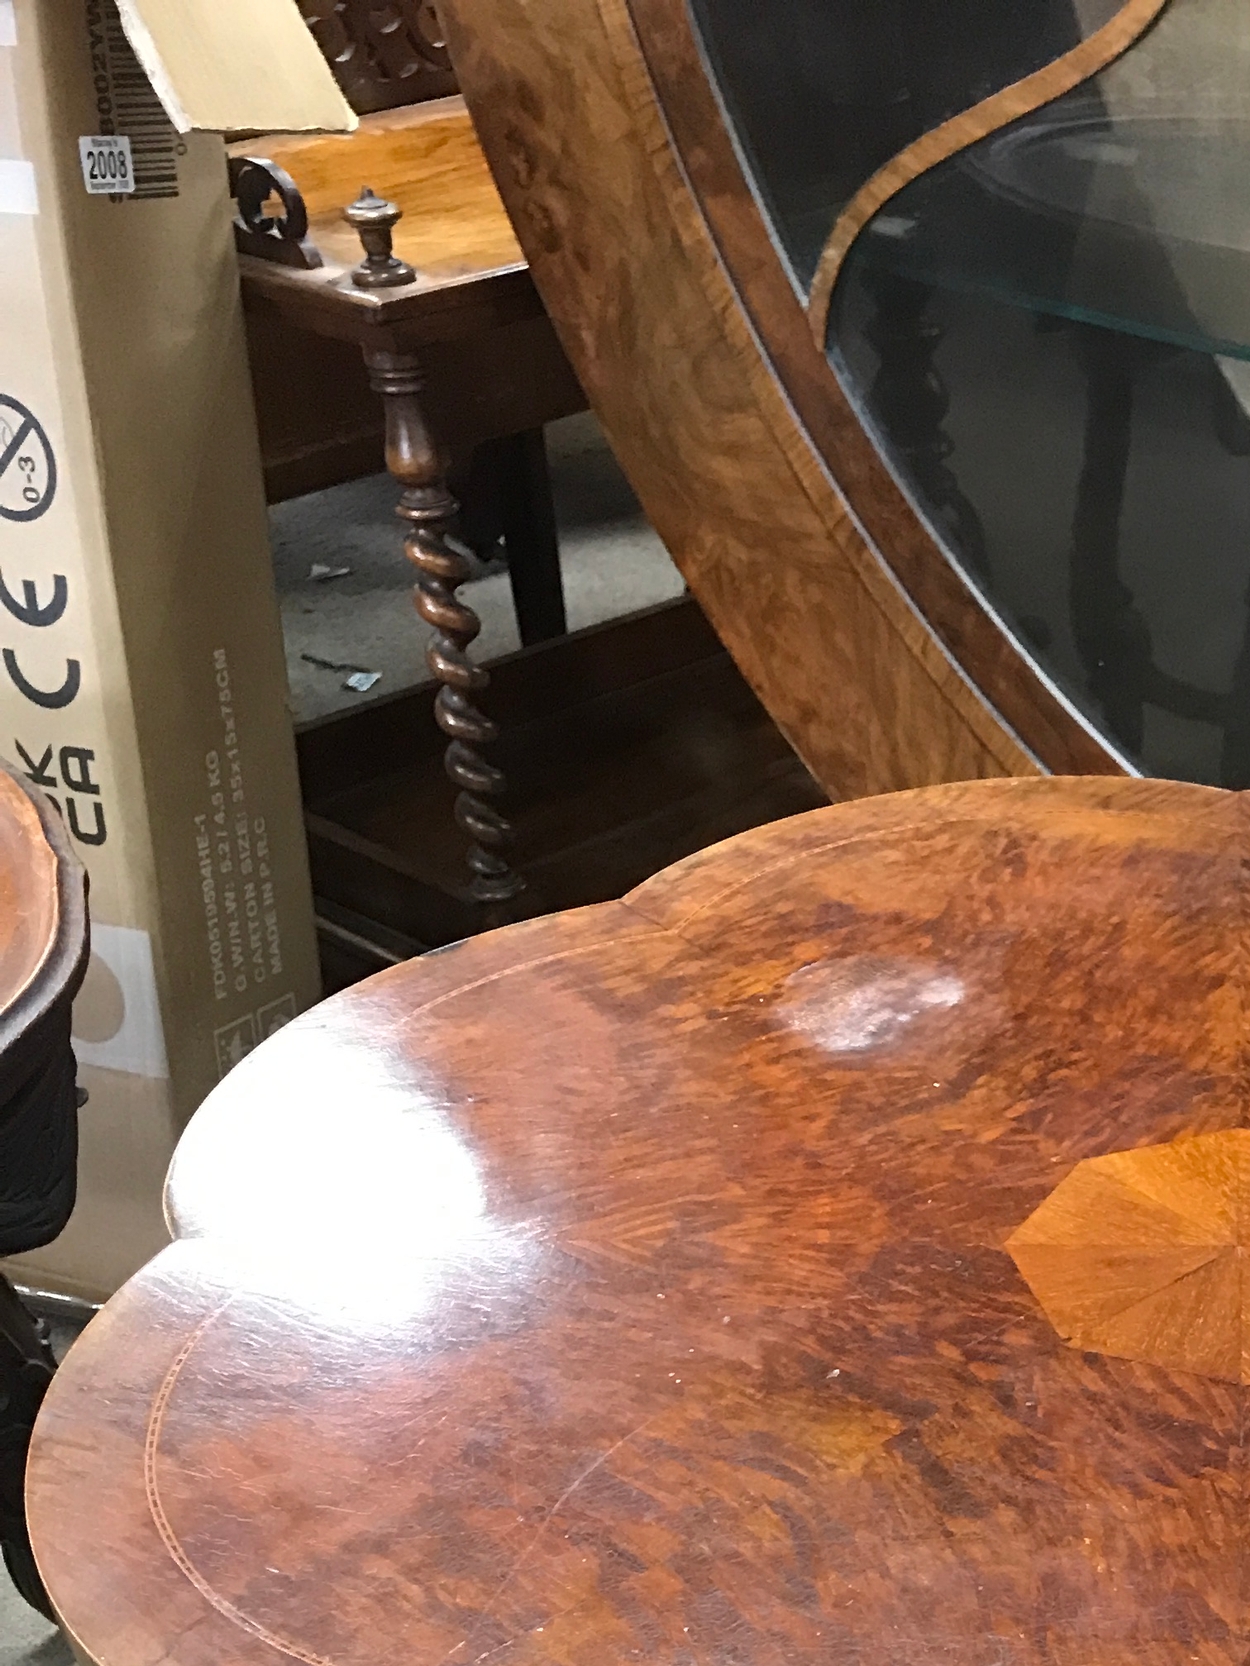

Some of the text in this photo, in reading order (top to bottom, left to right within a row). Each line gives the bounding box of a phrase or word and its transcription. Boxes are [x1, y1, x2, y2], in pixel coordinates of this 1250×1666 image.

[87, 150, 128, 180] 2008
[18, 456, 41, 503] 0-3
[0, 565, 80, 710] CE
[59, 746, 107, 846] CA
[205, 750, 221, 788] KG
[261, 881, 275, 906] IN
[243, 882, 267, 983] CARTON
[264, 909, 283, 975] MADE
